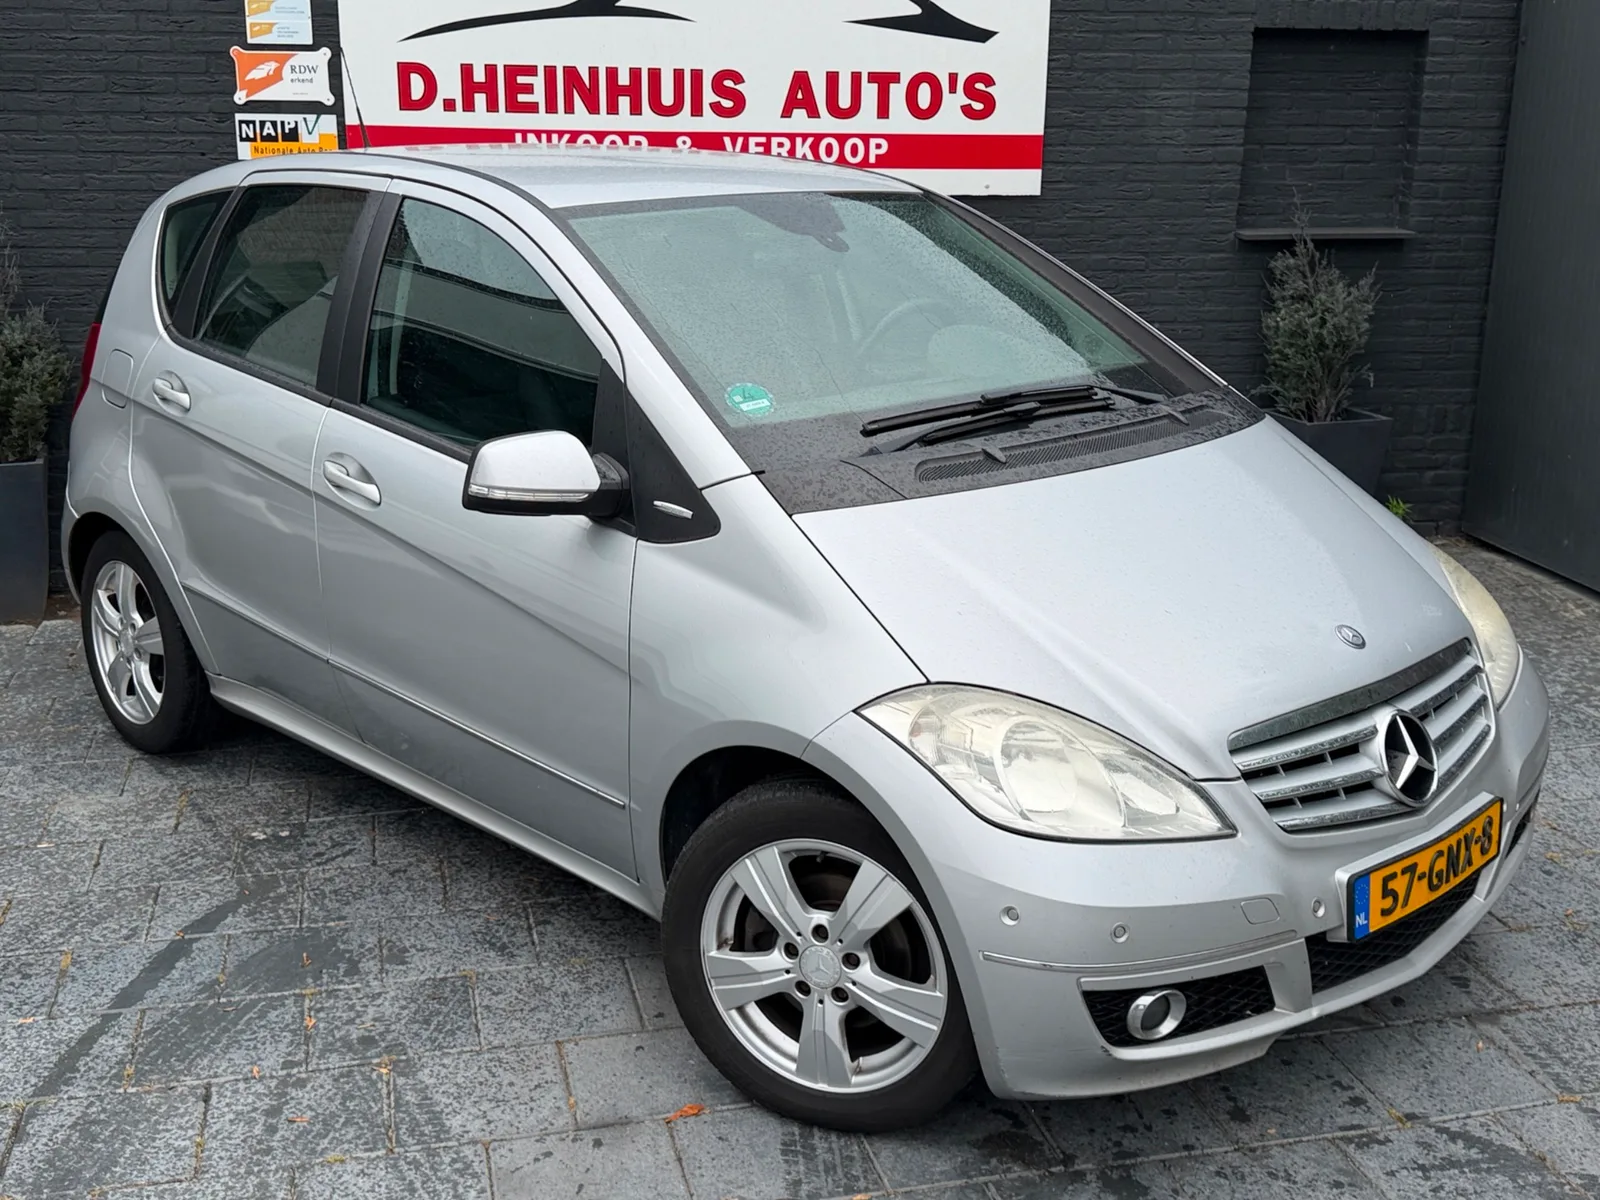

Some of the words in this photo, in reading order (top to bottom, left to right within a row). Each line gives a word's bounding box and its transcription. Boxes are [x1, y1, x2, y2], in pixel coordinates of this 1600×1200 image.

[290, 65, 319, 74] RDW
[396, 61, 747, 119] D.HEINHUIS
[779, 70, 997, 121] AUTO'S
[253, 146, 293, 155] Nationale
[1380, 815, 1494, 917] 57-GNX-8
[1355, 912, 1368, 928] NL
